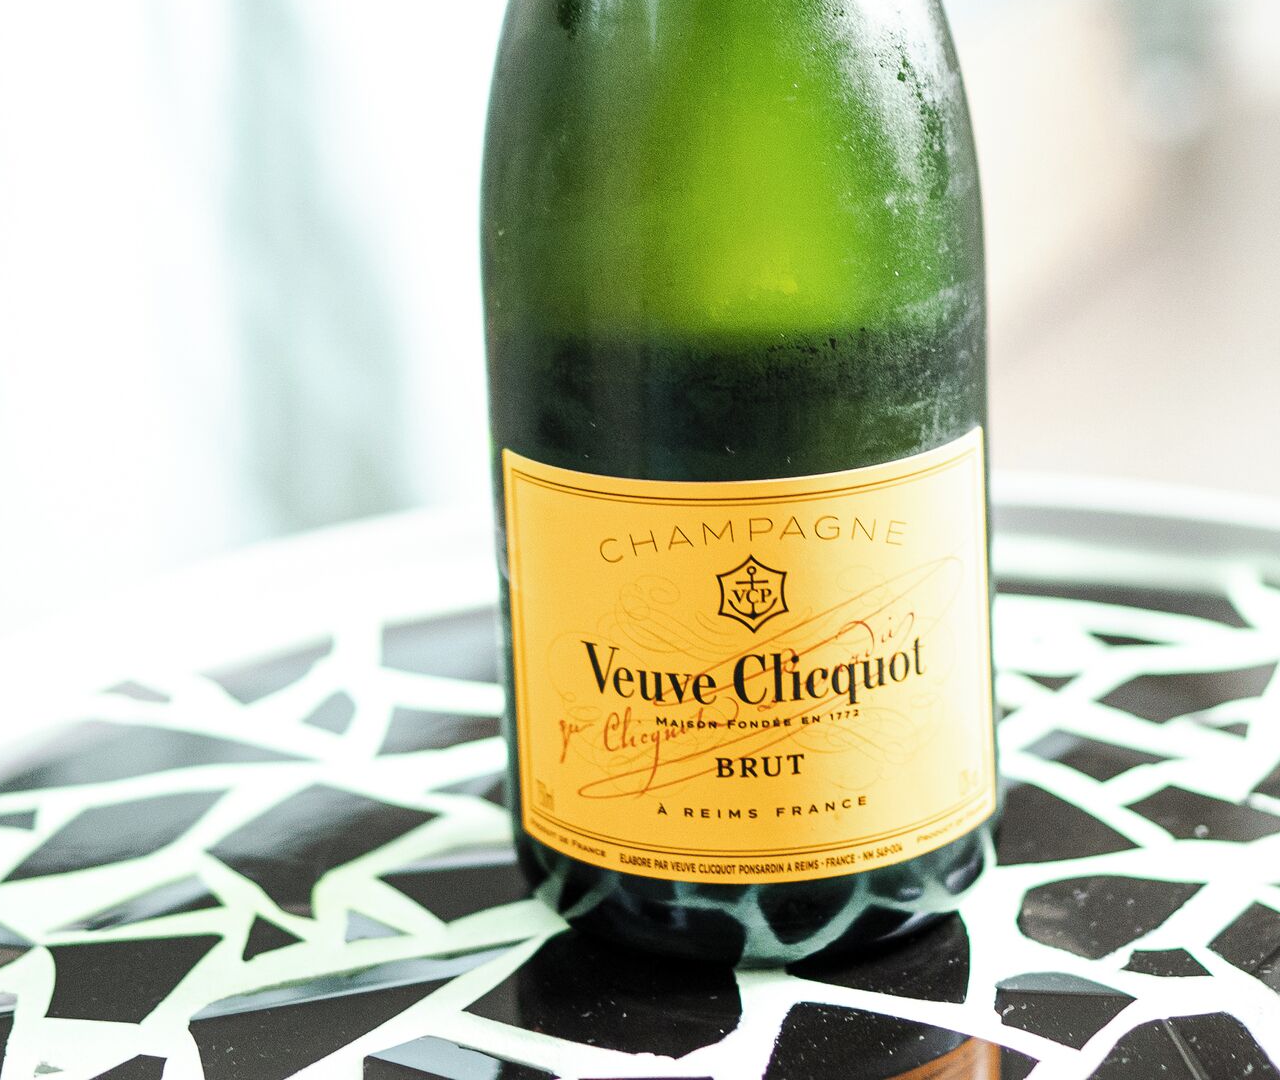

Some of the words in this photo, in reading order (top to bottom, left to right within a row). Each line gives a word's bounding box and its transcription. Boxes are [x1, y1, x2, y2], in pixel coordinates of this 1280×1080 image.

[600, 514, 909, 564] CHAMPAGNE
[731, 588, 772, 604] VCP
[581, 639, 717, 705] Veuve
[733, 636, 927, 706] Clicquot
[656, 716, 718, 729] MAISON
[801, 715, 821, 725] EN
[829, 709, 860, 721] 1772
[715, 753, 805, 778] BRUT
[657, 802, 668, 815] À
[684, 807, 759, 819] REIMS
[776, 795, 867, 817] FRANCE
[654, 859, 669, 870] PAR
[670, 861, 696, 873] VEUVE
[699, 863, 736, 875] CLICQUOT
[739, 863, 785, 875] PONSARDIN
[794, 859, 819, 872] REIMS
[825, 853, 856, 869] FRANCE
